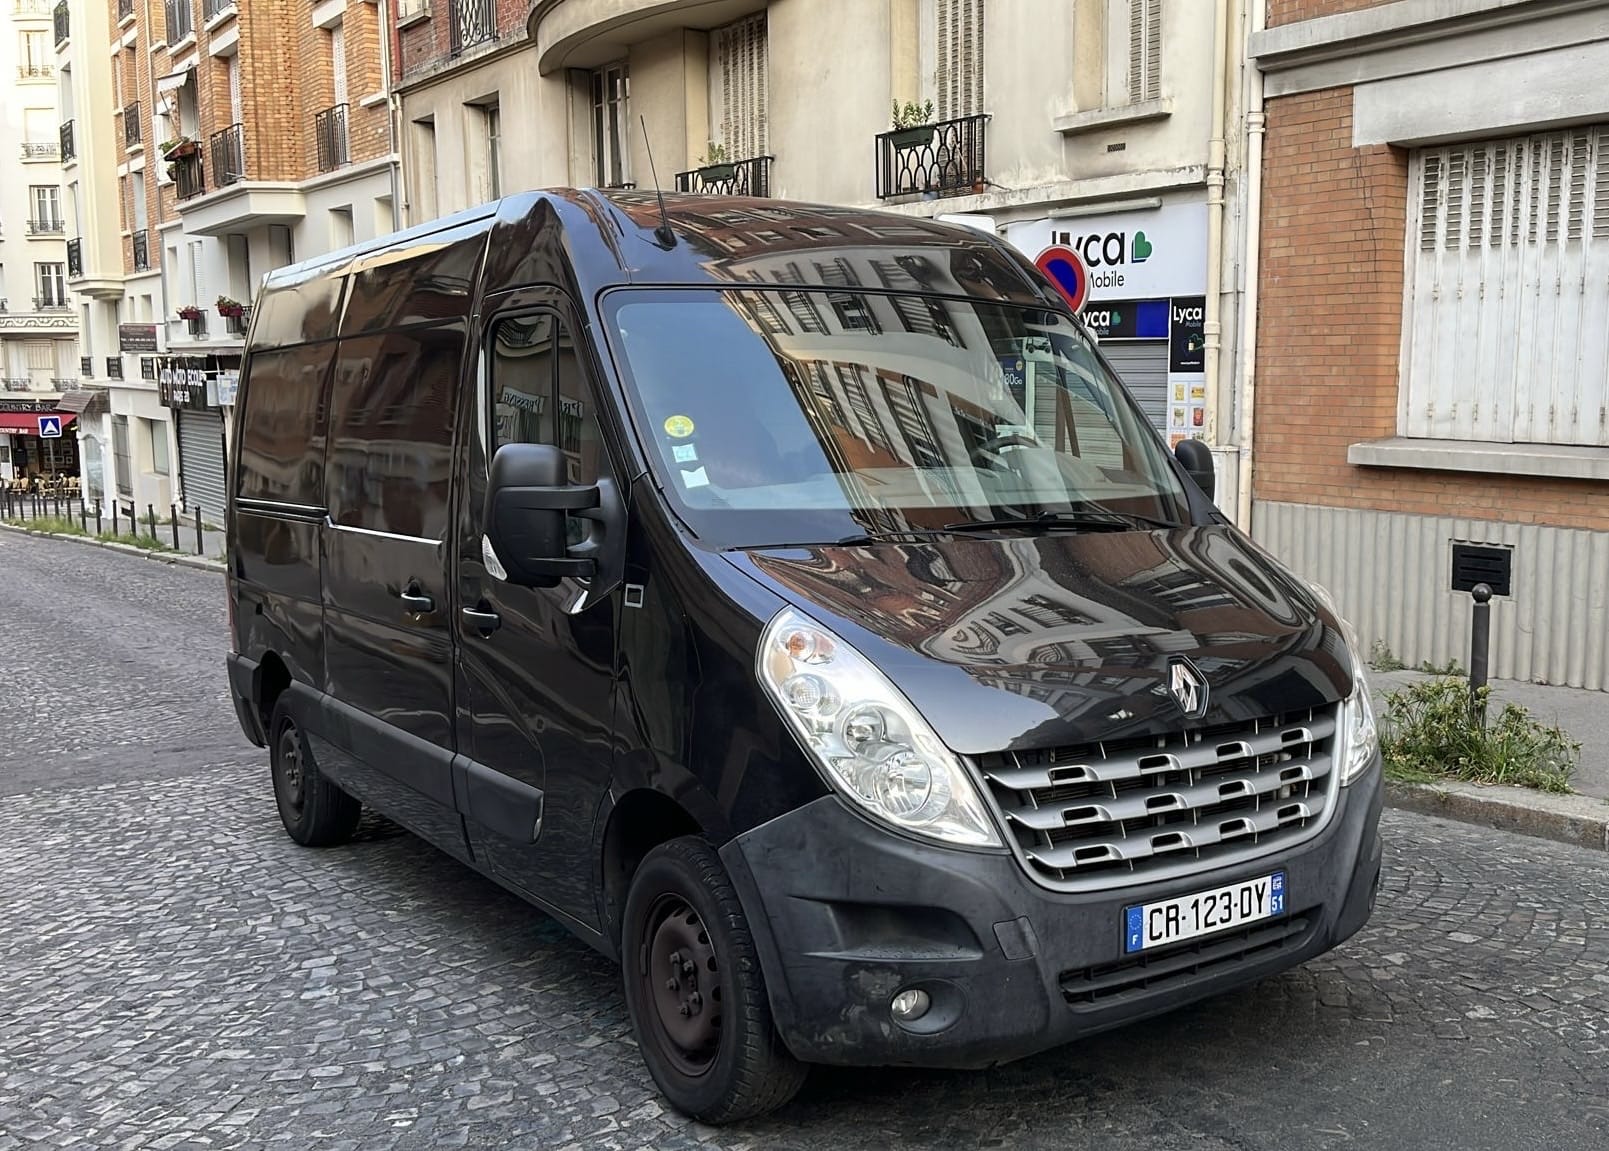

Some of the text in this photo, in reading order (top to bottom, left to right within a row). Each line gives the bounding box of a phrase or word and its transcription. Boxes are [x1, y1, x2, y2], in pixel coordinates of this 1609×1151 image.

[1082, 310, 1110, 328] yca
[1173, 305, 1202, 324] Lyca
[160, 368, 172, 384] AUTO
[1149, 881, 1266, 941] CR-123-DY
[1271, 894, 1283, 912] 51
[1132, 934, 1138, 945] F
